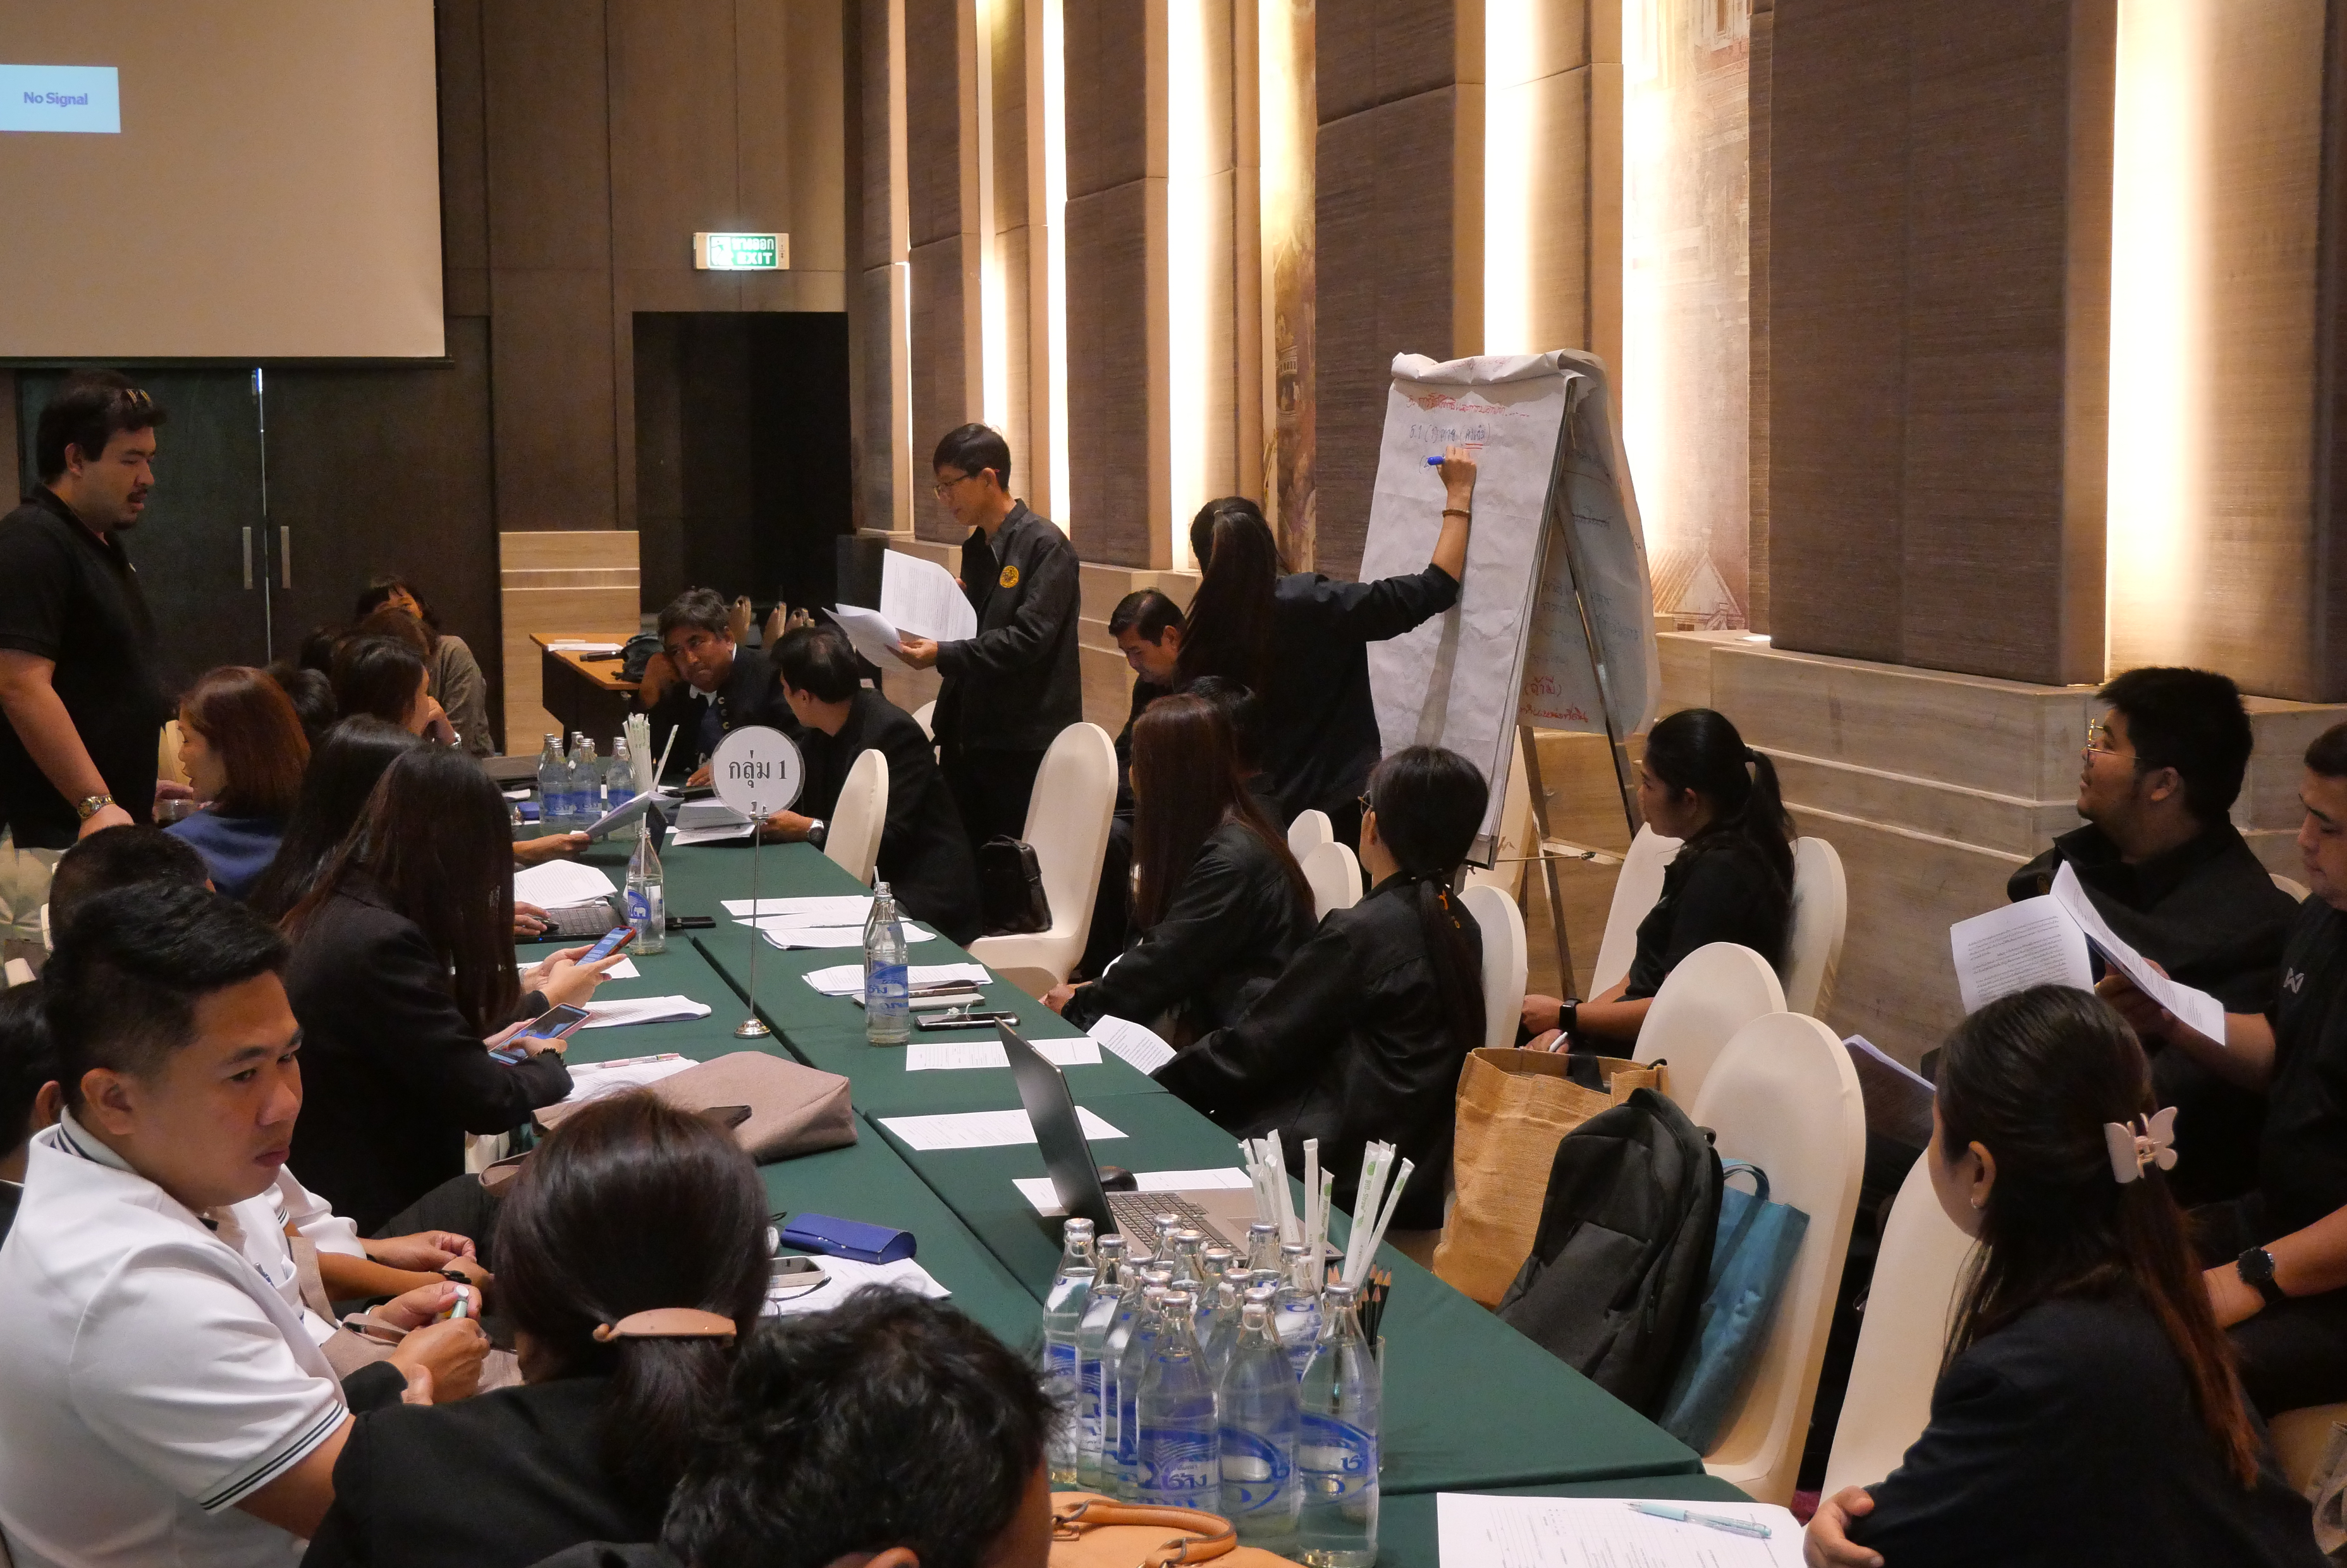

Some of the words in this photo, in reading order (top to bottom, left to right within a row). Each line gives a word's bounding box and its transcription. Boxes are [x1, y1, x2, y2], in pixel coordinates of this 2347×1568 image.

[23, 92, 44, 104] No
[46, 92, 88, 107] Signal
[737, 252, 773, 265] EXIT
[729, 750, 770, 788] กลุ่ม
[778, 759, 788, 780] 1
